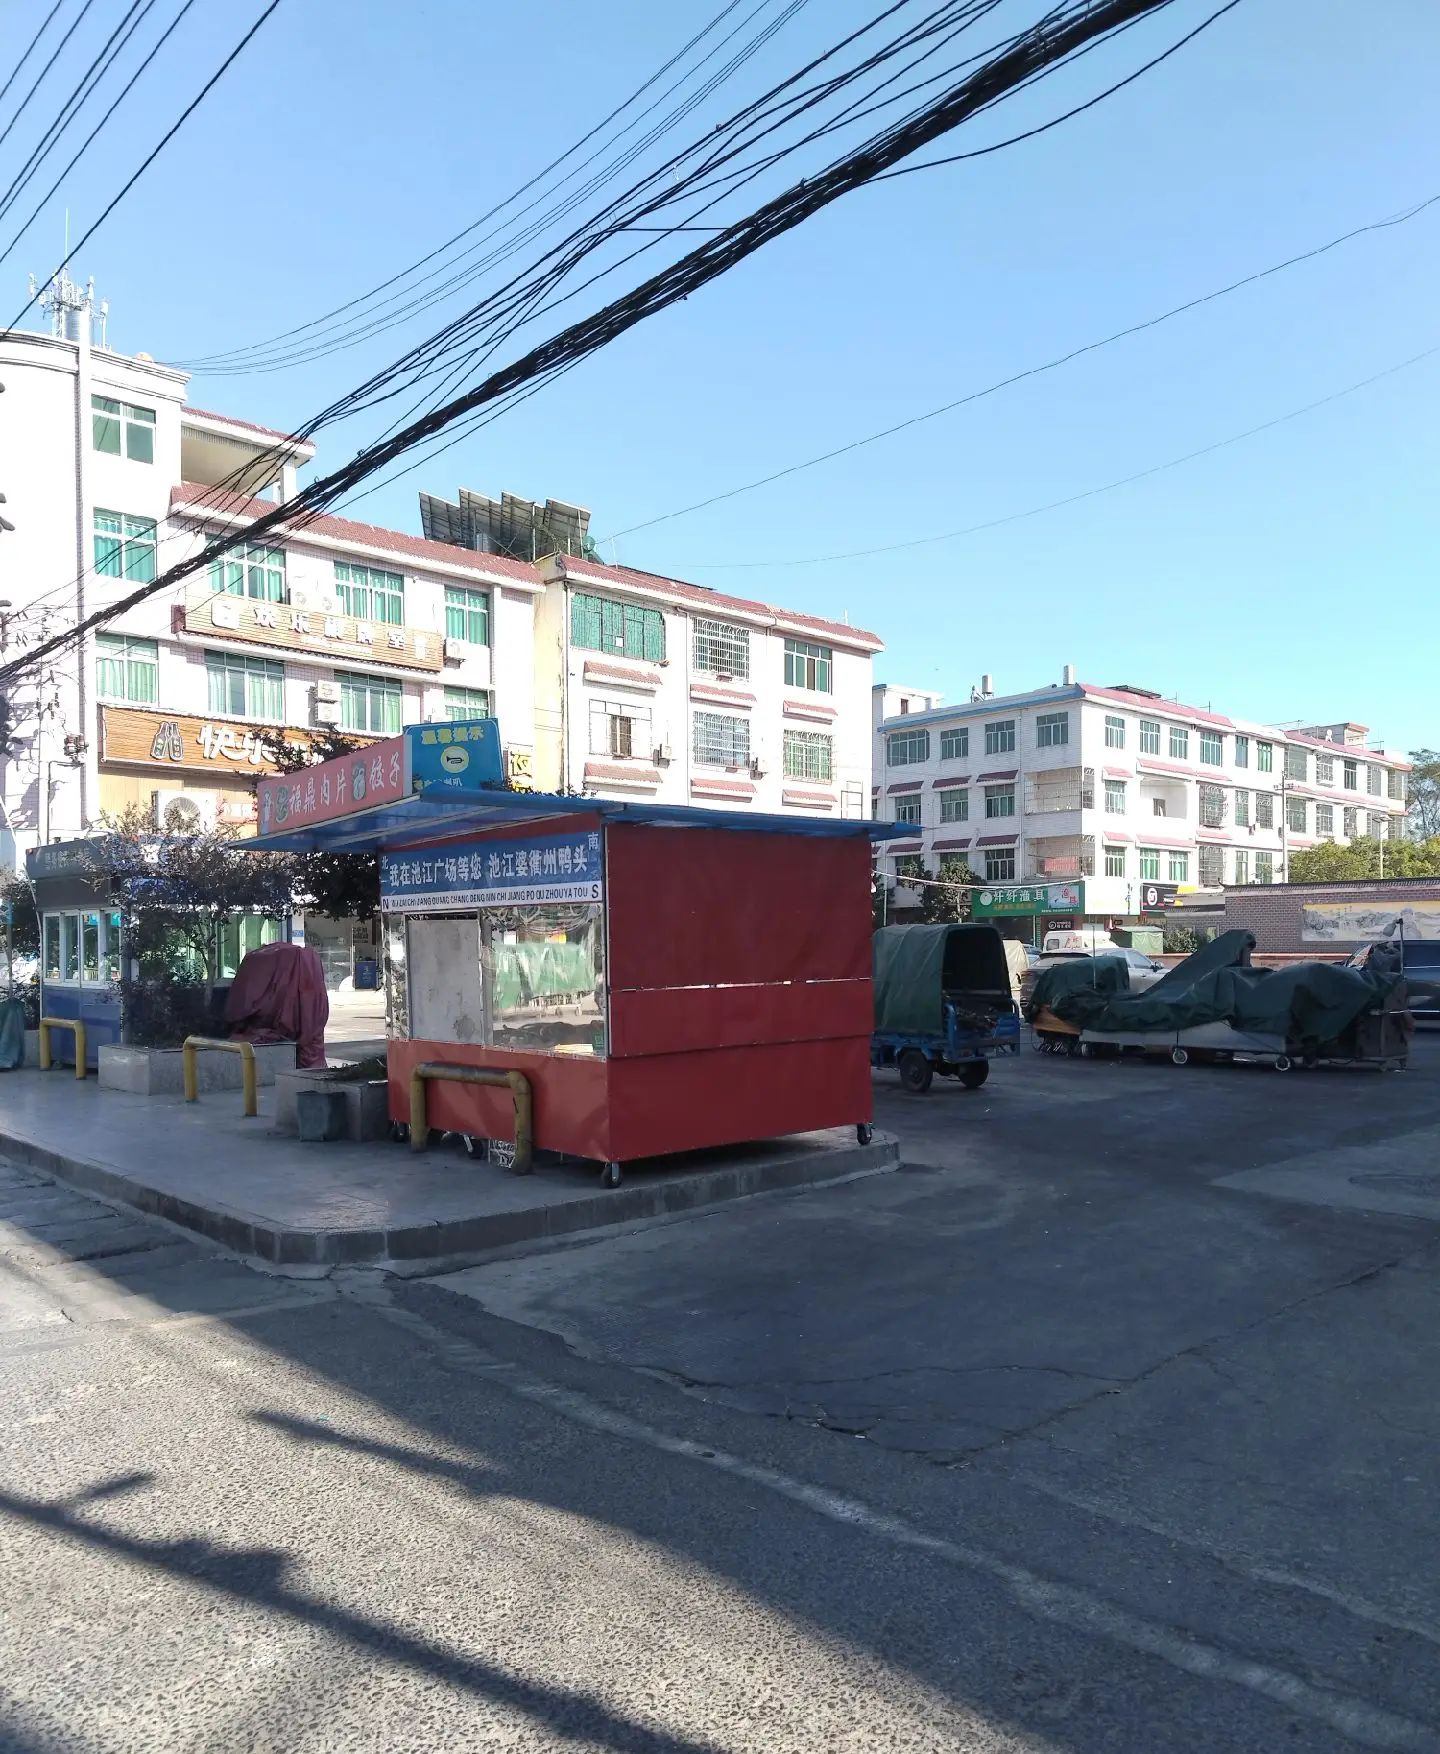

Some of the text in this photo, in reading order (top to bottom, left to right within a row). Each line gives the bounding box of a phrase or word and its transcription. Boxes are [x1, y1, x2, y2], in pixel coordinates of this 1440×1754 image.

[289, 768, 347, 816] 福鼎肉片
[369, 752, 400, 791] 饺子
[587, 832, 599, 850] 南
[389, 852, 482, 887] 我在池江广场等您
[591, 883, 599, 899] S
[382, 897, 390, 909] N
